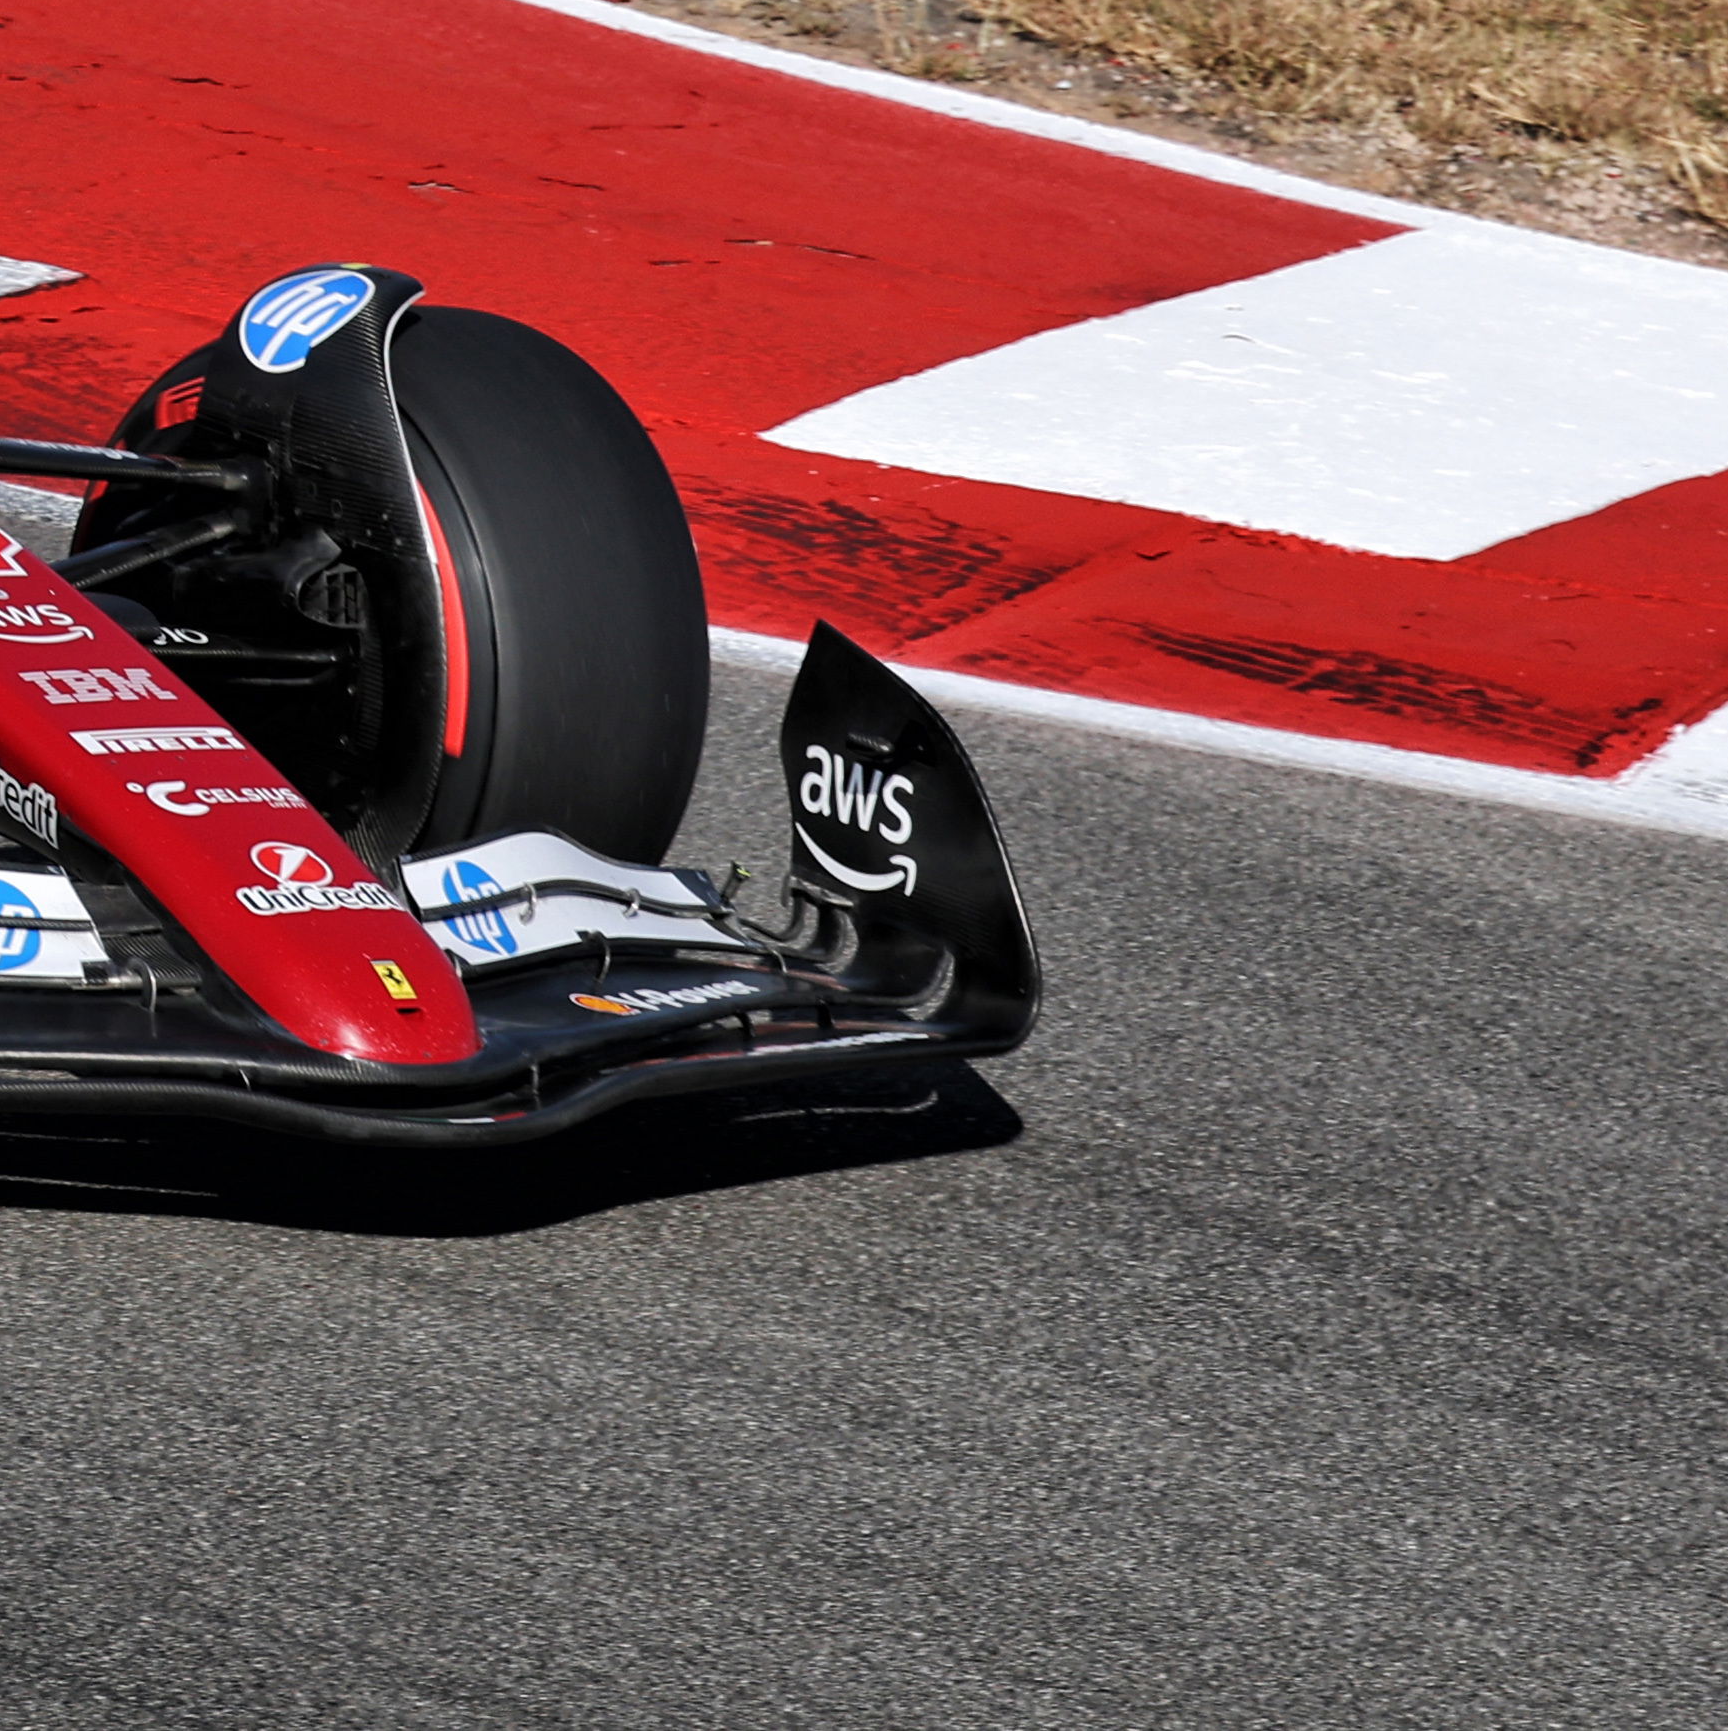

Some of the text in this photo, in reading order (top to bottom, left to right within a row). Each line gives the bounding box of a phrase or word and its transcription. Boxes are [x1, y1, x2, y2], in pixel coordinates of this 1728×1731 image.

[18, 668, 179, 705] IBM
[69, 726, 246, 756] PIRELLI
[799, 744, 915, 846] aws
[239, 881, 401, 915] UniCredit
[443, 860, 513, 956] hp
